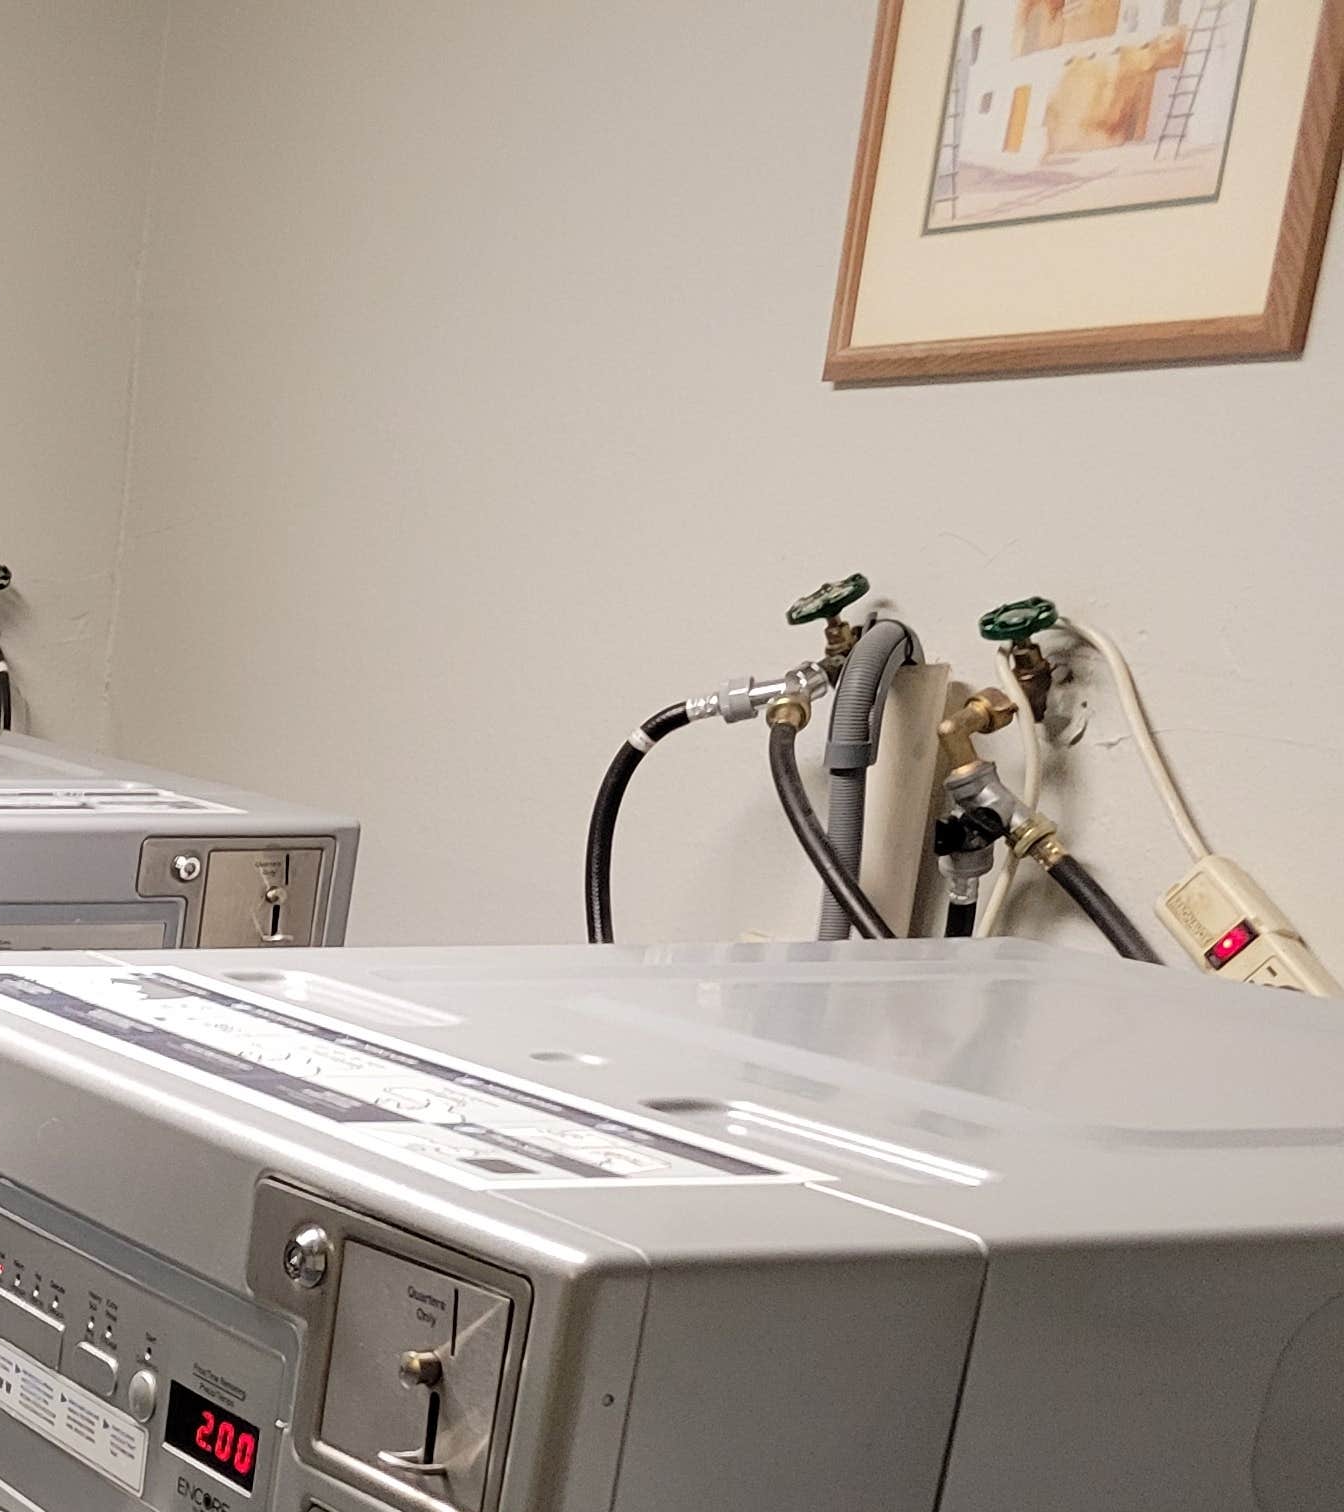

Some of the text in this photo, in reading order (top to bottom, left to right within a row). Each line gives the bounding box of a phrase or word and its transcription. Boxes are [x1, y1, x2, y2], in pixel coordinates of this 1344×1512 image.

[407, 1285, 447, 1311] Quarters
[415, 1307, 437, 1328] Only
[195, 1410, 257, 1475] 2.00
